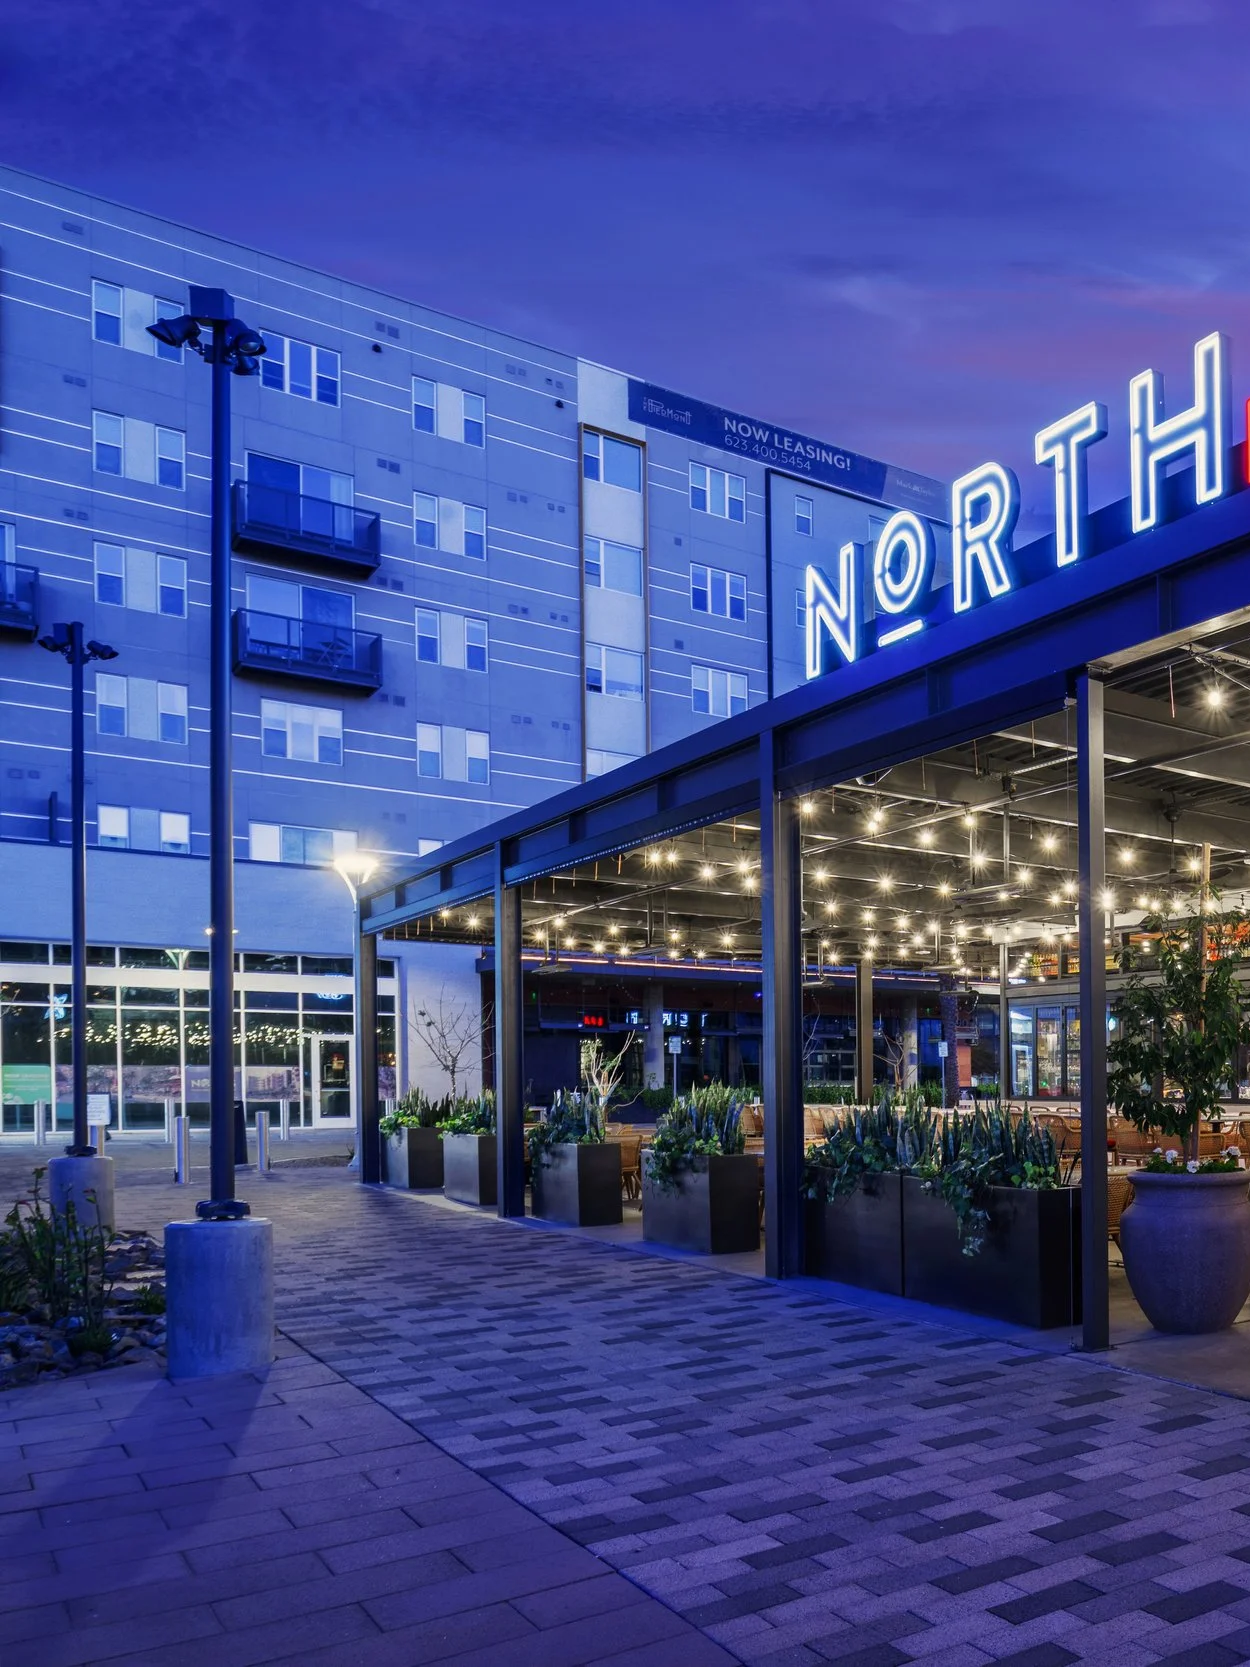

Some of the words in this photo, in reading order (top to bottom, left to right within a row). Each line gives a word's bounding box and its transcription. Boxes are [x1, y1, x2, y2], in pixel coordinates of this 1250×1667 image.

[724, 416, 770, 443] NOW
[774, 432, 852, 471] LEASING!
[724, 434, 812, 472] 623.400.5454
[805, 330, 1230, 681] NORTH
